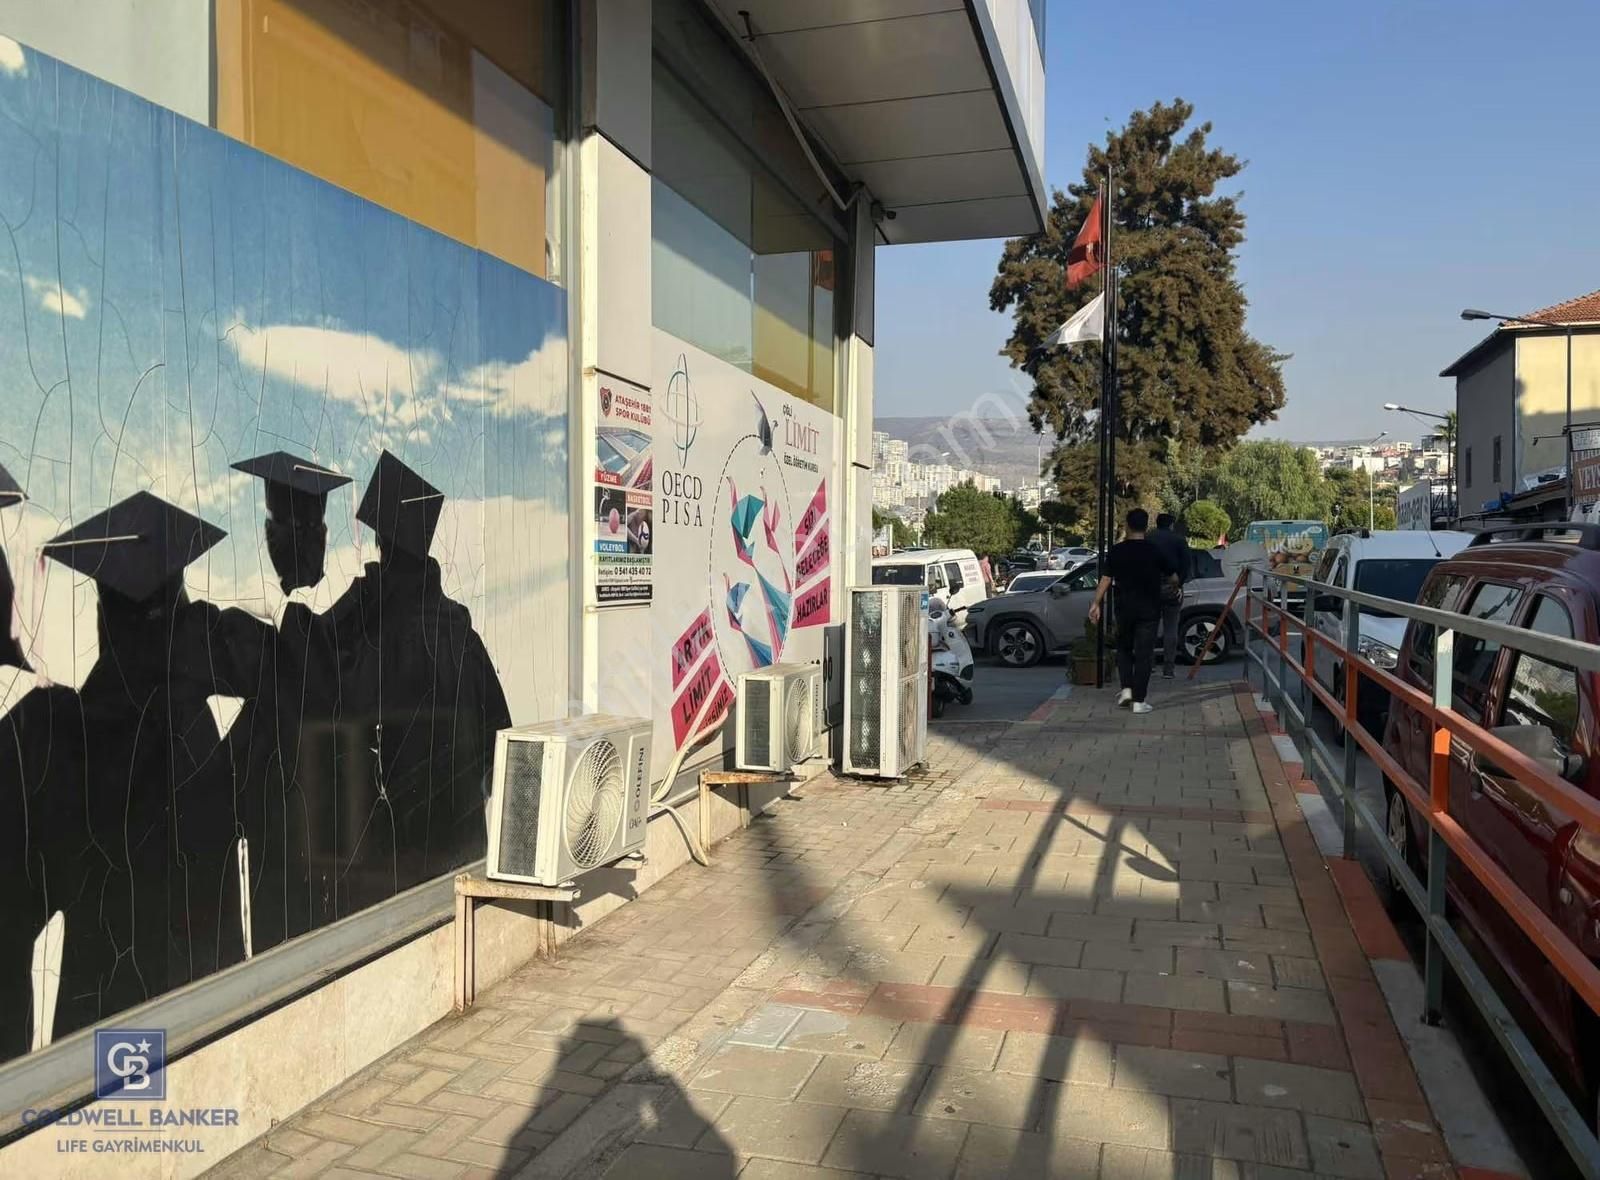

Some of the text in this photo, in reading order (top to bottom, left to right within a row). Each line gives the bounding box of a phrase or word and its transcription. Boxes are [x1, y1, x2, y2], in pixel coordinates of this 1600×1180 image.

[615, 394, 640, 409] ATAŞEHİR
[615, 407, 652, 426] SPOR KULÜBÜ
[785, 414, 819, 454] LİMİT
[662, 470, 703, 501] OECD
[662, 498, 703, 527] PISA
[599, 542, 625, 552] VOLEYBOL
[796, 588, 828, 623] HAZIRLAR
[682, 665, 712, 724] LİMİT
